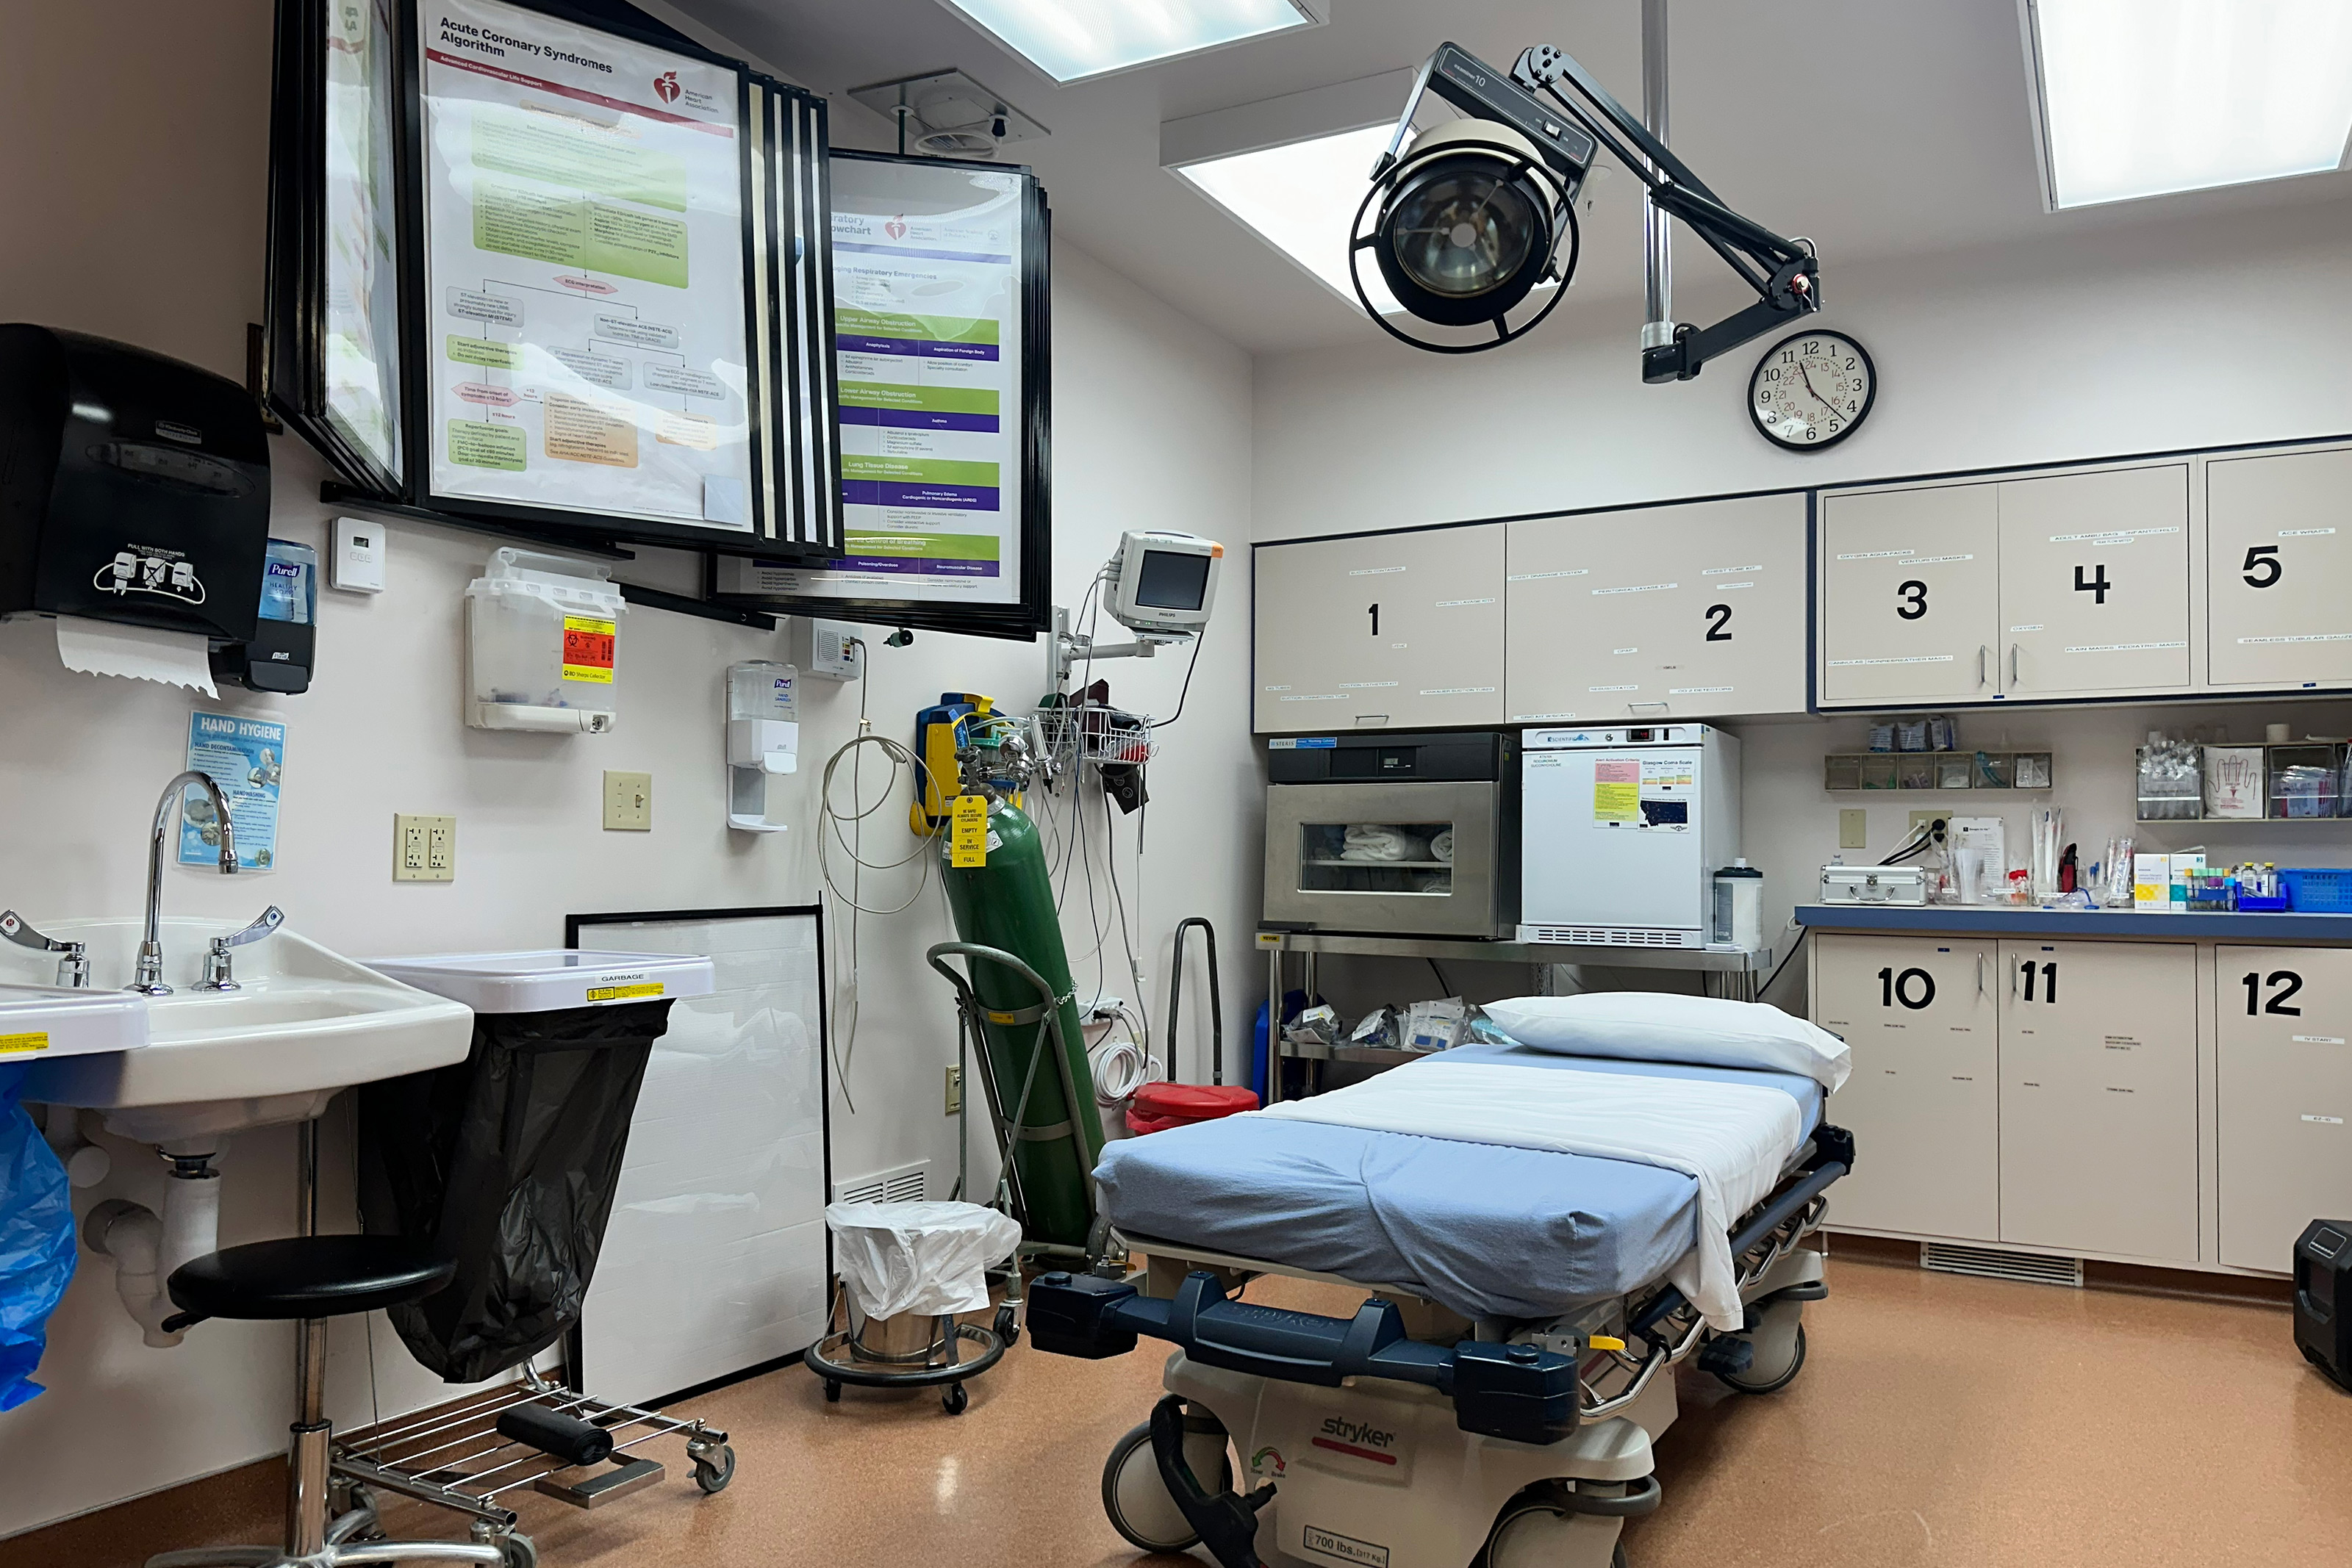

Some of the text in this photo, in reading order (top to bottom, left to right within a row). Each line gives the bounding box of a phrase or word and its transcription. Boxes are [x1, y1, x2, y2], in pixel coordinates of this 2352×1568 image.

[440, 30, 506, 57] Algorithm
[440, 17, 613, 73] Acute Coronary Syndromes
[440, 55, 542, 87] Advanced Cardiovascular Life Support
[1474, 74, 1486, 87] 10
[685, 89, 713, 100] American
[685, 96, 702, 104] Heart
[831, 214, 864, 226] ratory
[853, 266, 937, 280] Respiratory Emergencies
[575, 280, 606, 290] interpretation
[840, 315, 917, 327] Upper Airway Obstruction
[1802, 341, 1819, 355] 12
[1829, 345, 1838, 357] 1
[1781, 350, 1796, 364] 11
[1846, 357, 1855, 370] 2
[1804, 360, 1816, 370] 24
[1821, 363, 1829, 372] 13
[1763, 368, 1781, 382] 10
[1832, 370, 1840, 378] 14
[1782, 376, 1795, 386] 22
[1835, 383, 1845, 392] 15
[1852, 378, 1862, 391] 3
[859, 388, 881, 397] Airway
[881, 389, 917, 398] Obstruction
[1761, 390, 1771, 403] 9
[1779, 390, 1787, 400] 21
[1784, 402, 1796, 411] 20
[1831, 396, 1840, 406] 16
[1846, 400, 1857, 412] 4
[1766, 411, 1777, 424] 8
[1793, 410, 1803, 419] 19
[1807, 413, 1815, 422] 18
[1821, 406, 1829, 416] 17
[1784, 425, 1793, 438] 7
[1829, 419, 1839, 432] 5
[1806, 427, 1816, 440] 6
[848, 461, 863, 469] Lung
[271, 564, 297, 578] Purell
[2242, 545, 2282, 588] 5
[2074, 564, 2111, 604] 4
[1896, 580, 1928, 620] 3
[1368, 603, 1379, 636] 1
[1705, 603, 1732, 642] 2
[776, 680, 790, 688] Purell
[201, 717, 235, 734] HAND
[239, 722, 282, 741] HYGIENE
[232, 790, 266, 799] HANDWASHING
[601, 974, 645, 982] GARBAGE
[2020, 960, 2057, 1004] 11
[1878, 967, 1936, 1010] 10
[2242, 970, 2303, 1017] 12
[1321, 1417, 1394, 1448] stryker
[1315, 1535, 1334, 1550] 700
[1336, 1541, 1356, 1556] lbs.
